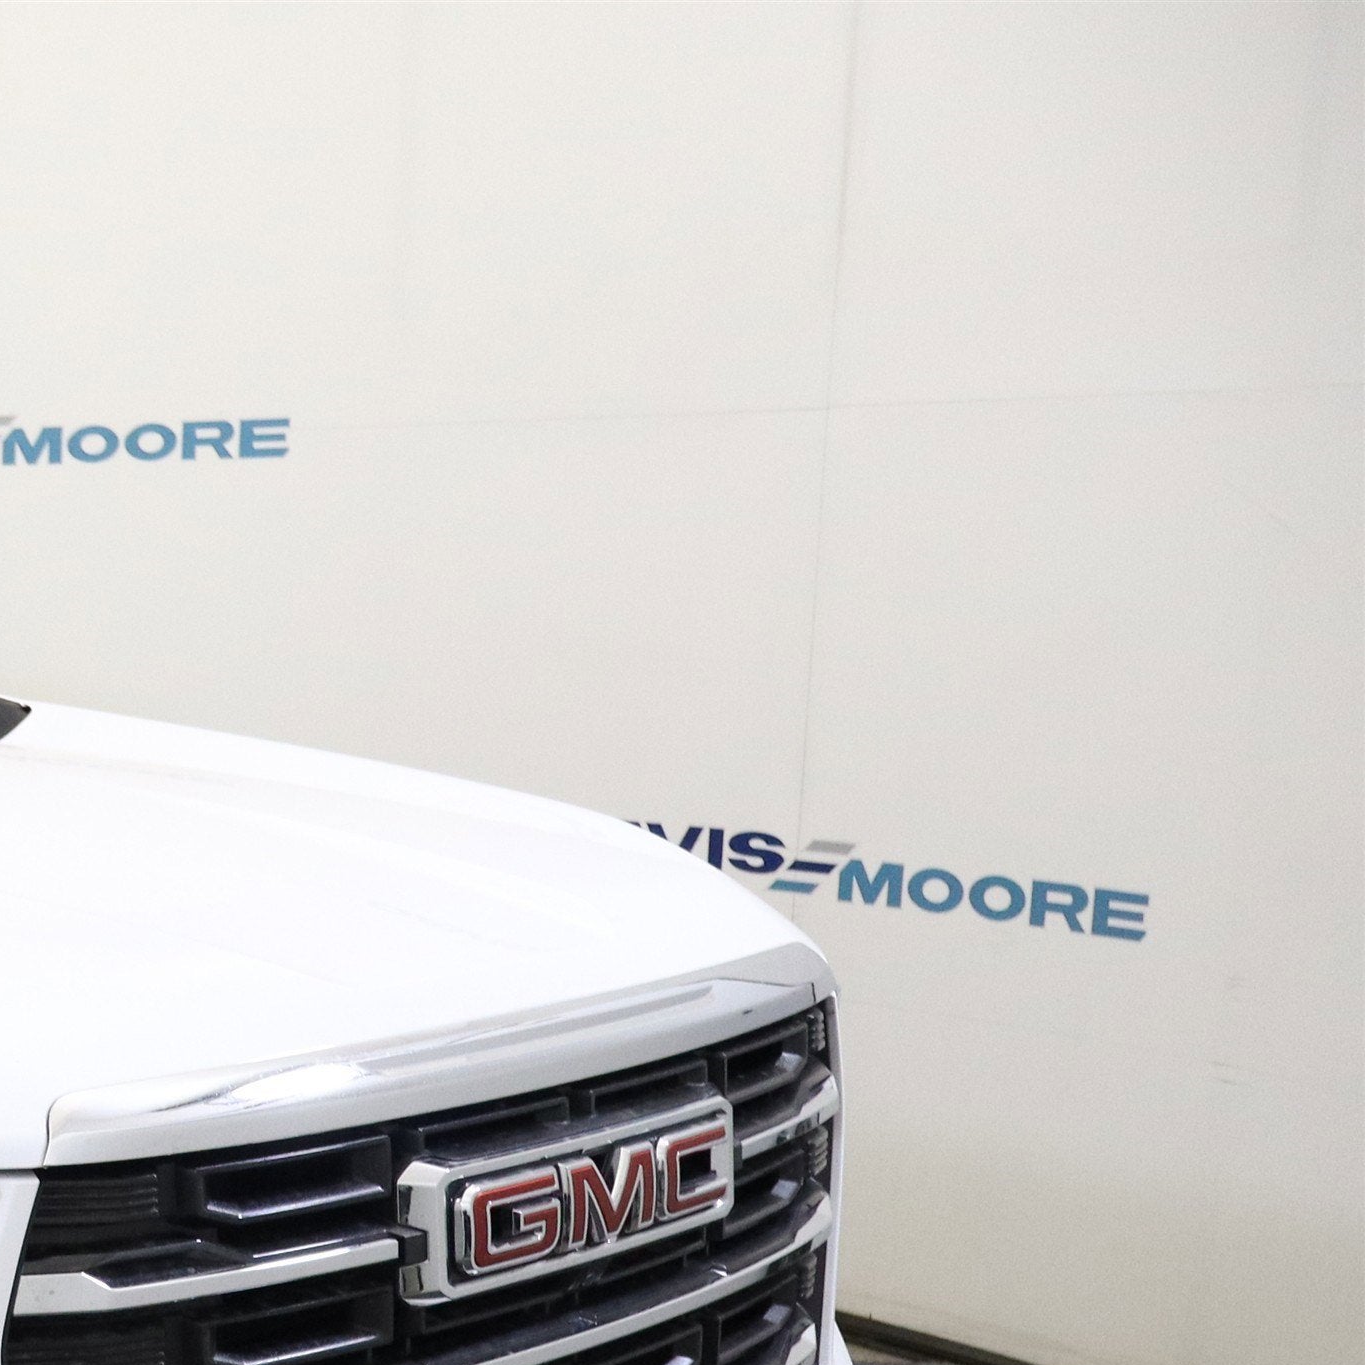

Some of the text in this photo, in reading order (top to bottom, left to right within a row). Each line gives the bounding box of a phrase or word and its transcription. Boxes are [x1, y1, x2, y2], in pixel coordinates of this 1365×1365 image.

[2, 418, 290, 465] MOORE
[837, 859, 1149, 942] MOORE
[456, 1117, 729, 1277] GMC
